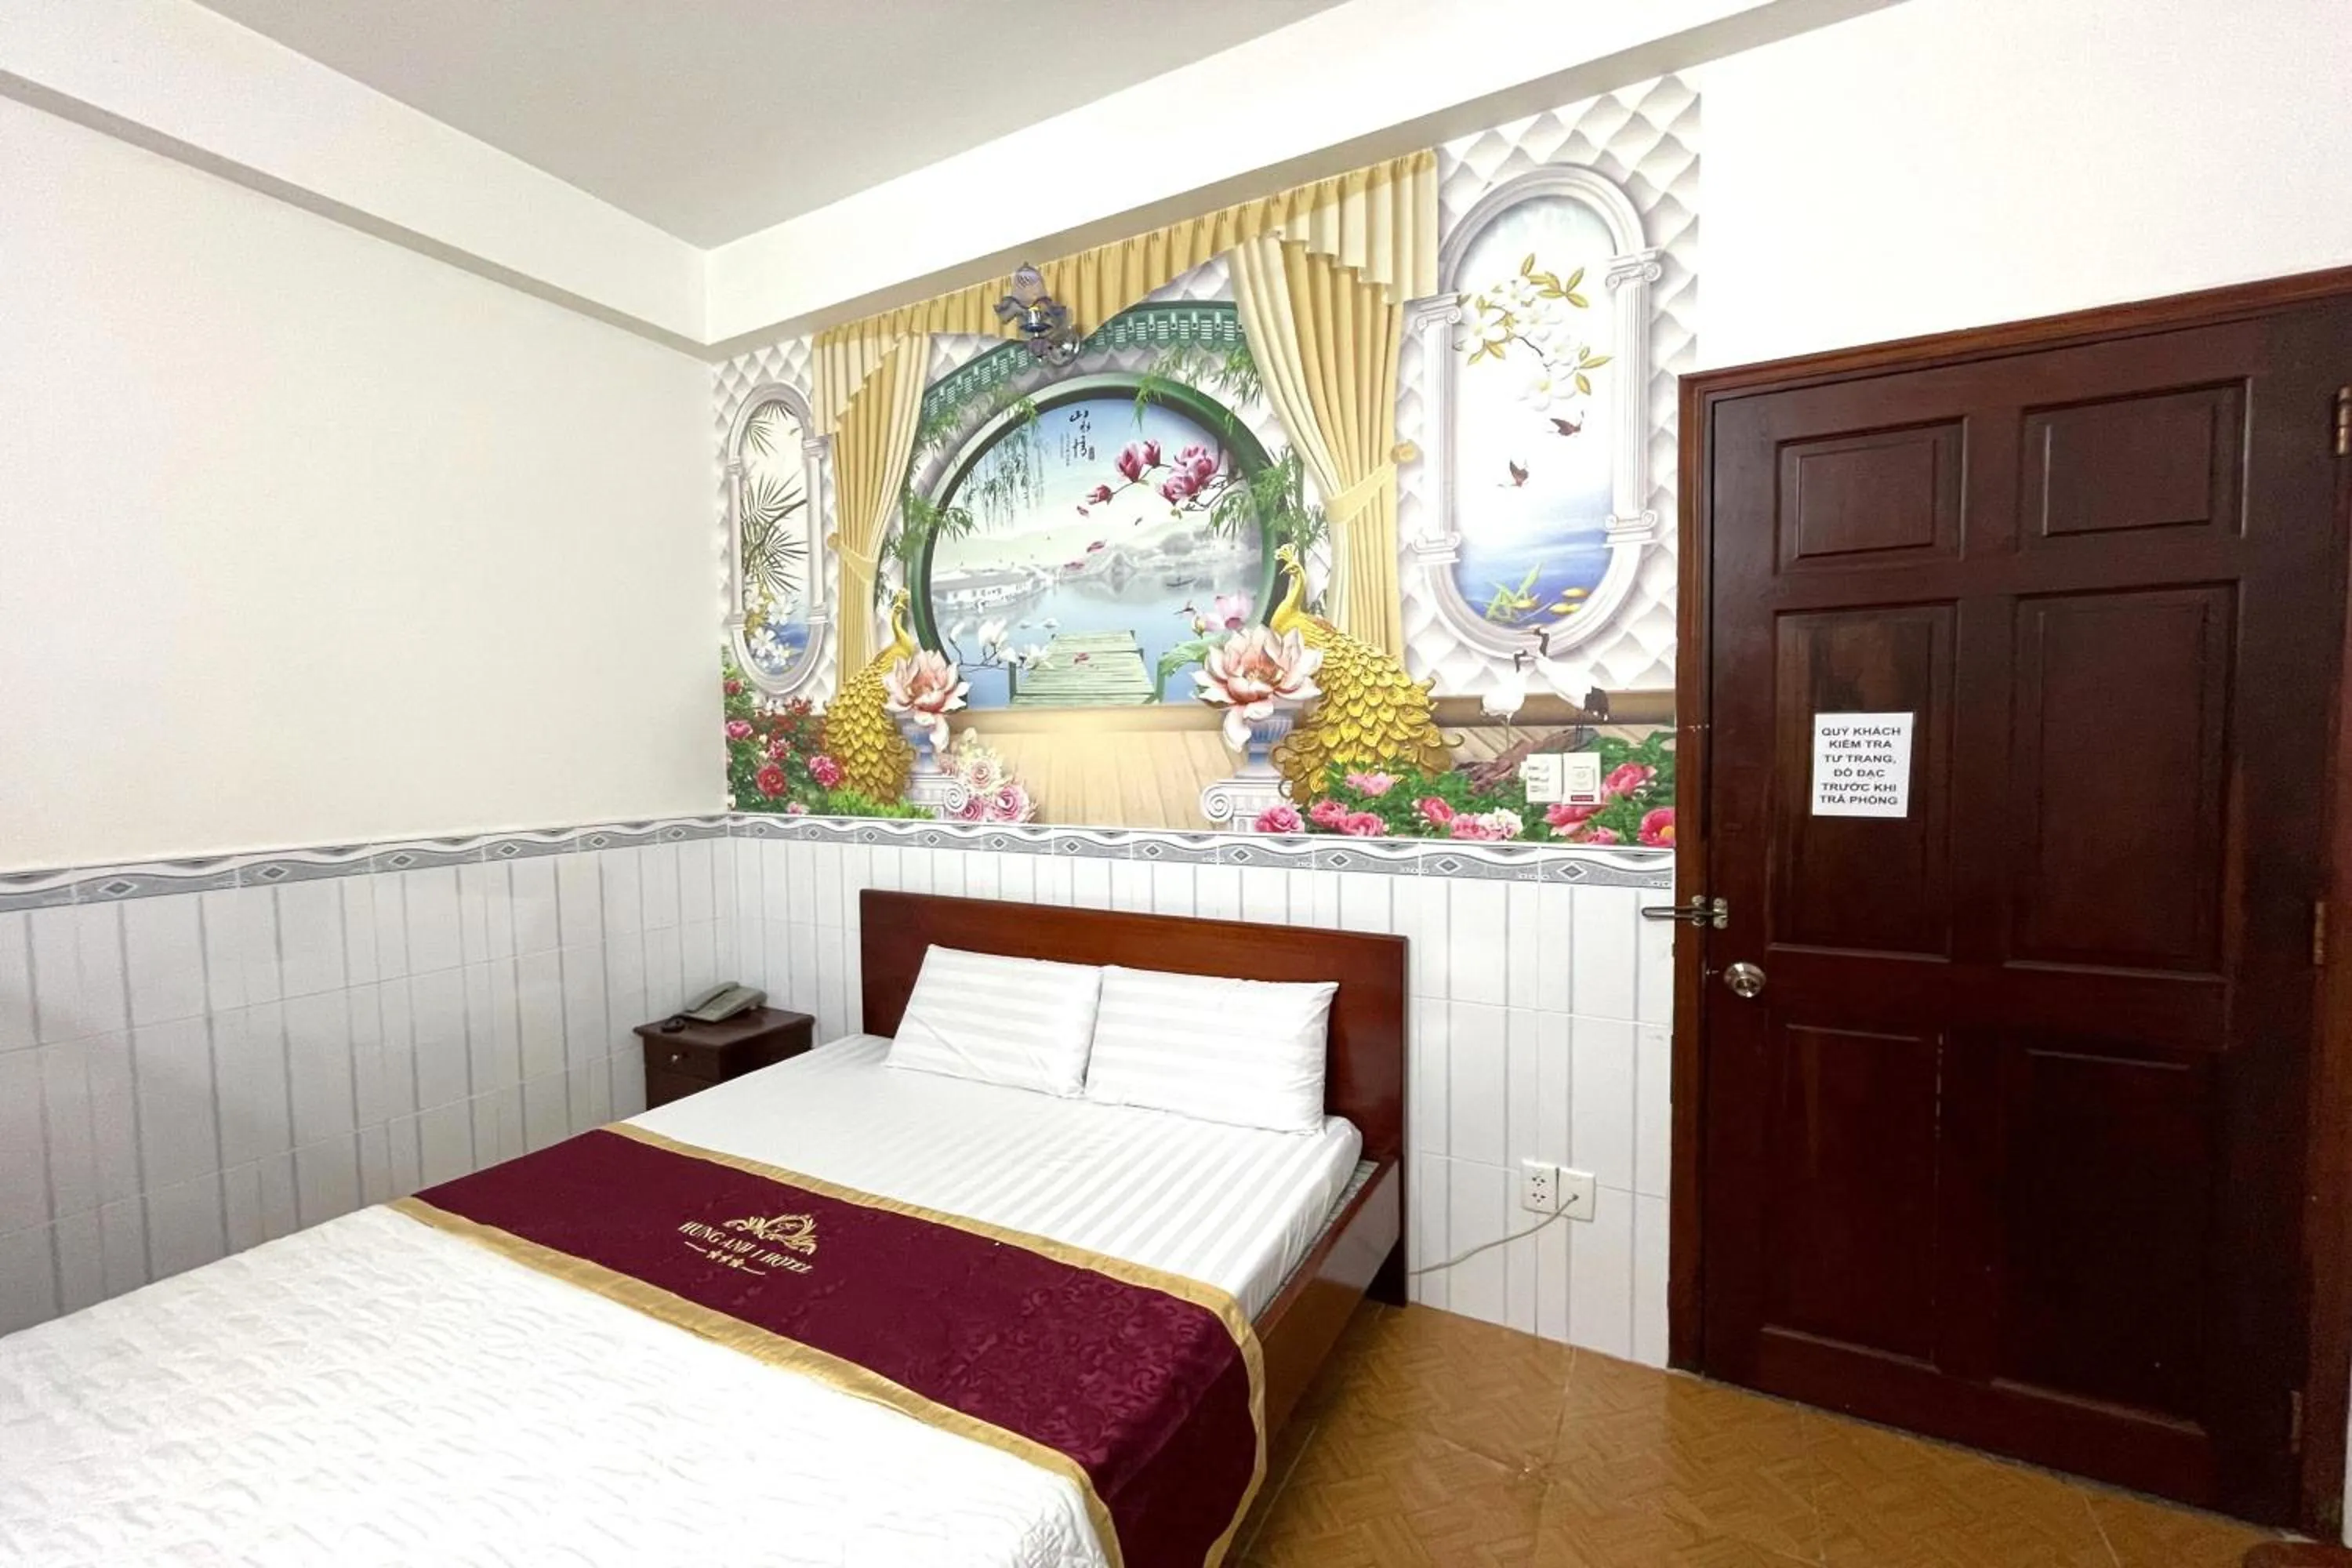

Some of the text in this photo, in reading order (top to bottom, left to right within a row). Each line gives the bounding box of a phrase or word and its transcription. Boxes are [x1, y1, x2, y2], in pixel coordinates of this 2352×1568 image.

[1864, 739, 1892, 749] TRA
[1874, 783, 1896, 792] KHI
[759, 1252, 813, 1272] HOTEL
